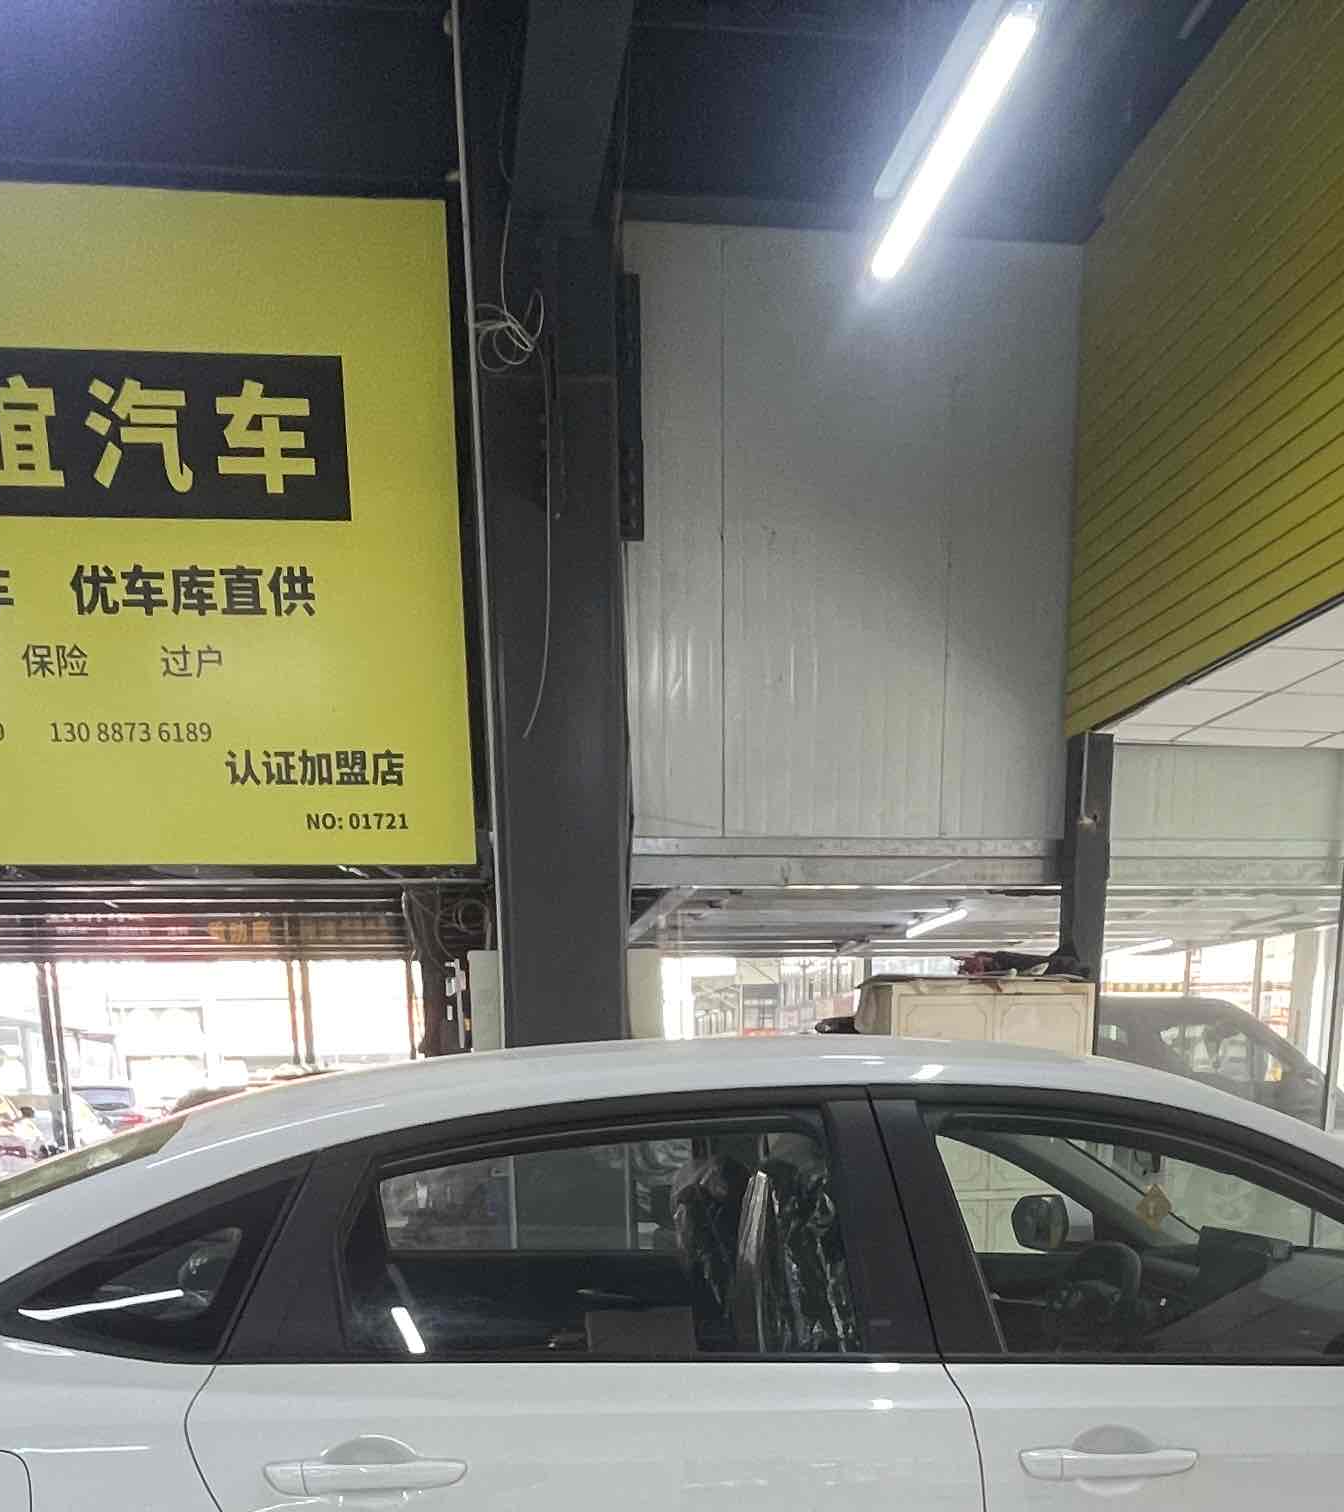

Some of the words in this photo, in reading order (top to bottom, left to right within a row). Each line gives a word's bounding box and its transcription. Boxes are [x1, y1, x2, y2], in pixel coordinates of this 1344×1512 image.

[69, 564, 316, 618] 优车库直供
[21, 643, 90, 679] 保险
[160, 645, 223, 679] 过户
[50, 721, 90, 743] 130
[96, 721, 152, 743] 8873
[158, 721, 213, 743] 6189
[225, 749, 405, 788] 认证加盟店
[306, 812, 344, 831] NO:
[348, 812, 409, 831] 01721
